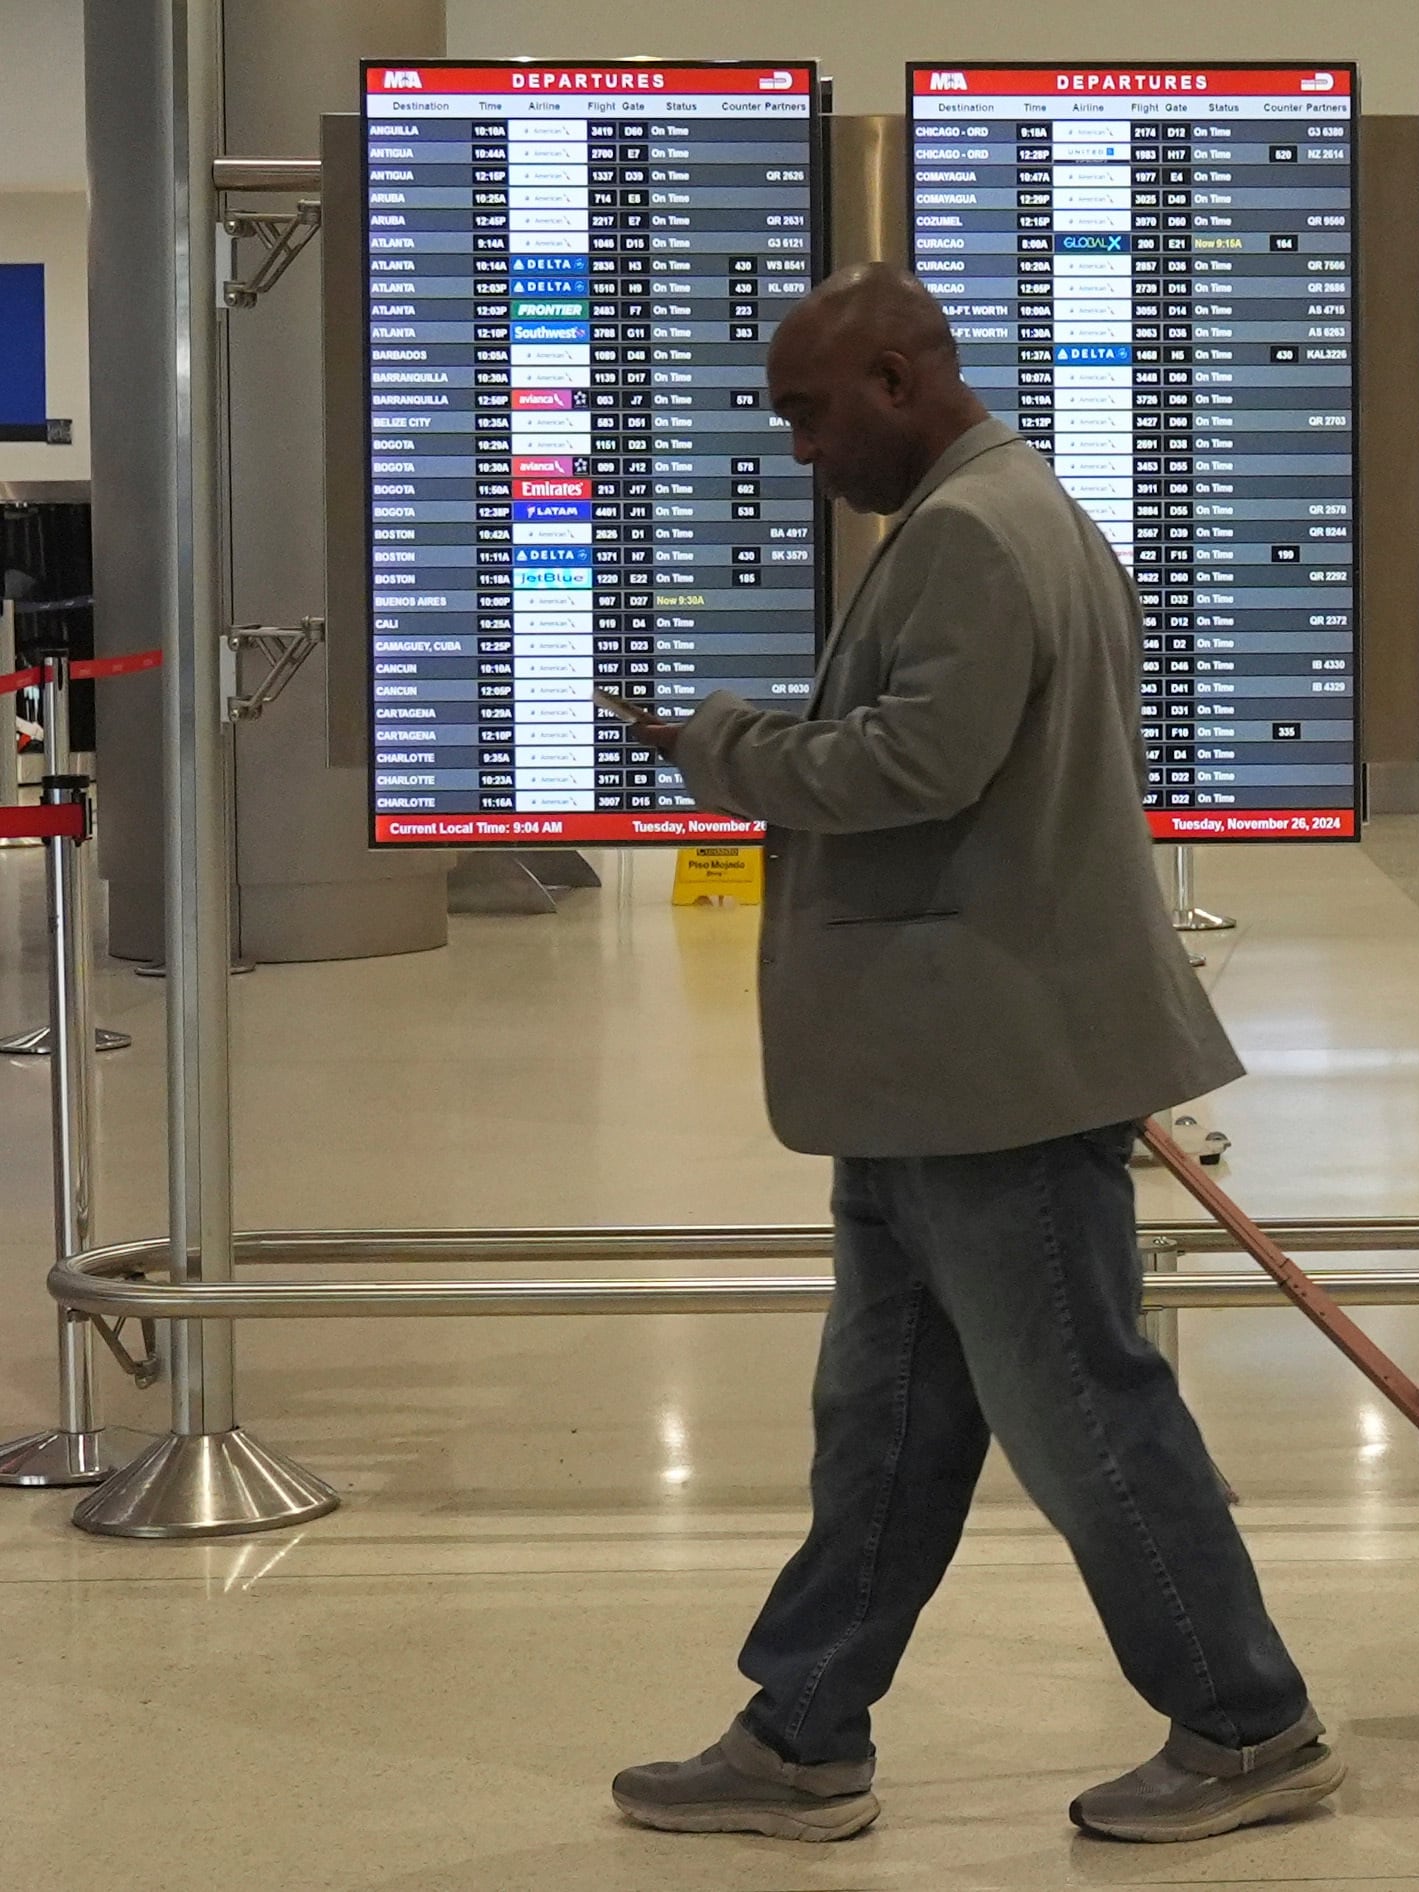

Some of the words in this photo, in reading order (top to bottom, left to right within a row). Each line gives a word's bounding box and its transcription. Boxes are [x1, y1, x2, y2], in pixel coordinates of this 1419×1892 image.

[513, 74, 664, 88] DEPARTURES
[1057, 75, 1207, 89] DEPARTURES
[393, 102, 449, 111] Destination
[479, 102, 502, 110] Time
[529, 102, 560, 110] Airline
[588, 102, 616, 113] Flight
[622, 102, 645, 111] Gate
[666, 102, 697, 111] Status
[722, 102, 761, 111] Counter
[765, 102, 806, 111] Partners
[939, 103, 994, 112] Destination
[1024, 103, 1047, 112] Time
[1072, 103, 1104, 112] Airline
[1131, 103, 1159, 114] Flight
[1165, 103, 1187, 112] Gate
[1209, 103, 1239, 112] Status
[1264, 103, 1302, 112] Counter
[1306, 103, 1347, 112] Partners
[370, 126, 419, 135] ANGUILLA
[651, 126, 665, 135] On
[667, 126, 689, 135] Time
[916, 127, 960, 137] CHICAGO
[370, 149, 413, 158] ANTIGUA
[916, 172, 977, 181] COMAYAGUA
[370, 193, 405, 203] ARUBA
[916, 217, 963, 226] COZUMEL
[917, 239, 964, 249] CURACAO
[371, 261, 415, 270] ATLANTA
[528, 260, 571, 269] DELTA
[518, 304, 582, 315] FRONTIER
[974, 306, 1008, 315] WORTH
[515, 326, 577, 339] Southwest
[373, 351, 427, 360] BARBADOS
[1071, 349, 1114, 358] DELTA
[373, 395, 449, 405] BARRANQUILLA
[519, 394, 554, 404] avianca
[373, 418, 405, 427] BELIZE
[407, 418, 431, 427] CITY
[374, 463, 415, 472] BOGOTA
[520, 462, 555, 471] avianca
[522, 481, 581, 496] Emirates
[537, 507, 578, 515] LATAM
[375, 552, 415, 562] BOSTON
[530, 550, 574, 560] DELTA
[375, 597, 416, 607] BUENOS
[417, 597, 447, 606] AIRES
[657, 596, 673, 605] Now
[375, 620, 398, 629] CALI
[376, 664, 417, 673] CANCUN
[376, 708, 436, 718] CARTAGENA
[377, 753, 435, 763] CHARLOTTE
[390, 823, 437, 834] Current
[440, 823, 470, 834] Local
[473, 822, 509, 833] Time:
[513, 822, 537, 833] 9:04
[542, 822, 562, 833] AM
[632, 821, 685, 835] Tuesday,
[689, 820, 751, 832] November
[1172, 818, 1224, 833] Tuesday,
[1227, 818, 1289, 829] November
[1292, 817, 1309, 832] 26,
[1312, 817, 1340, 829] 2024
